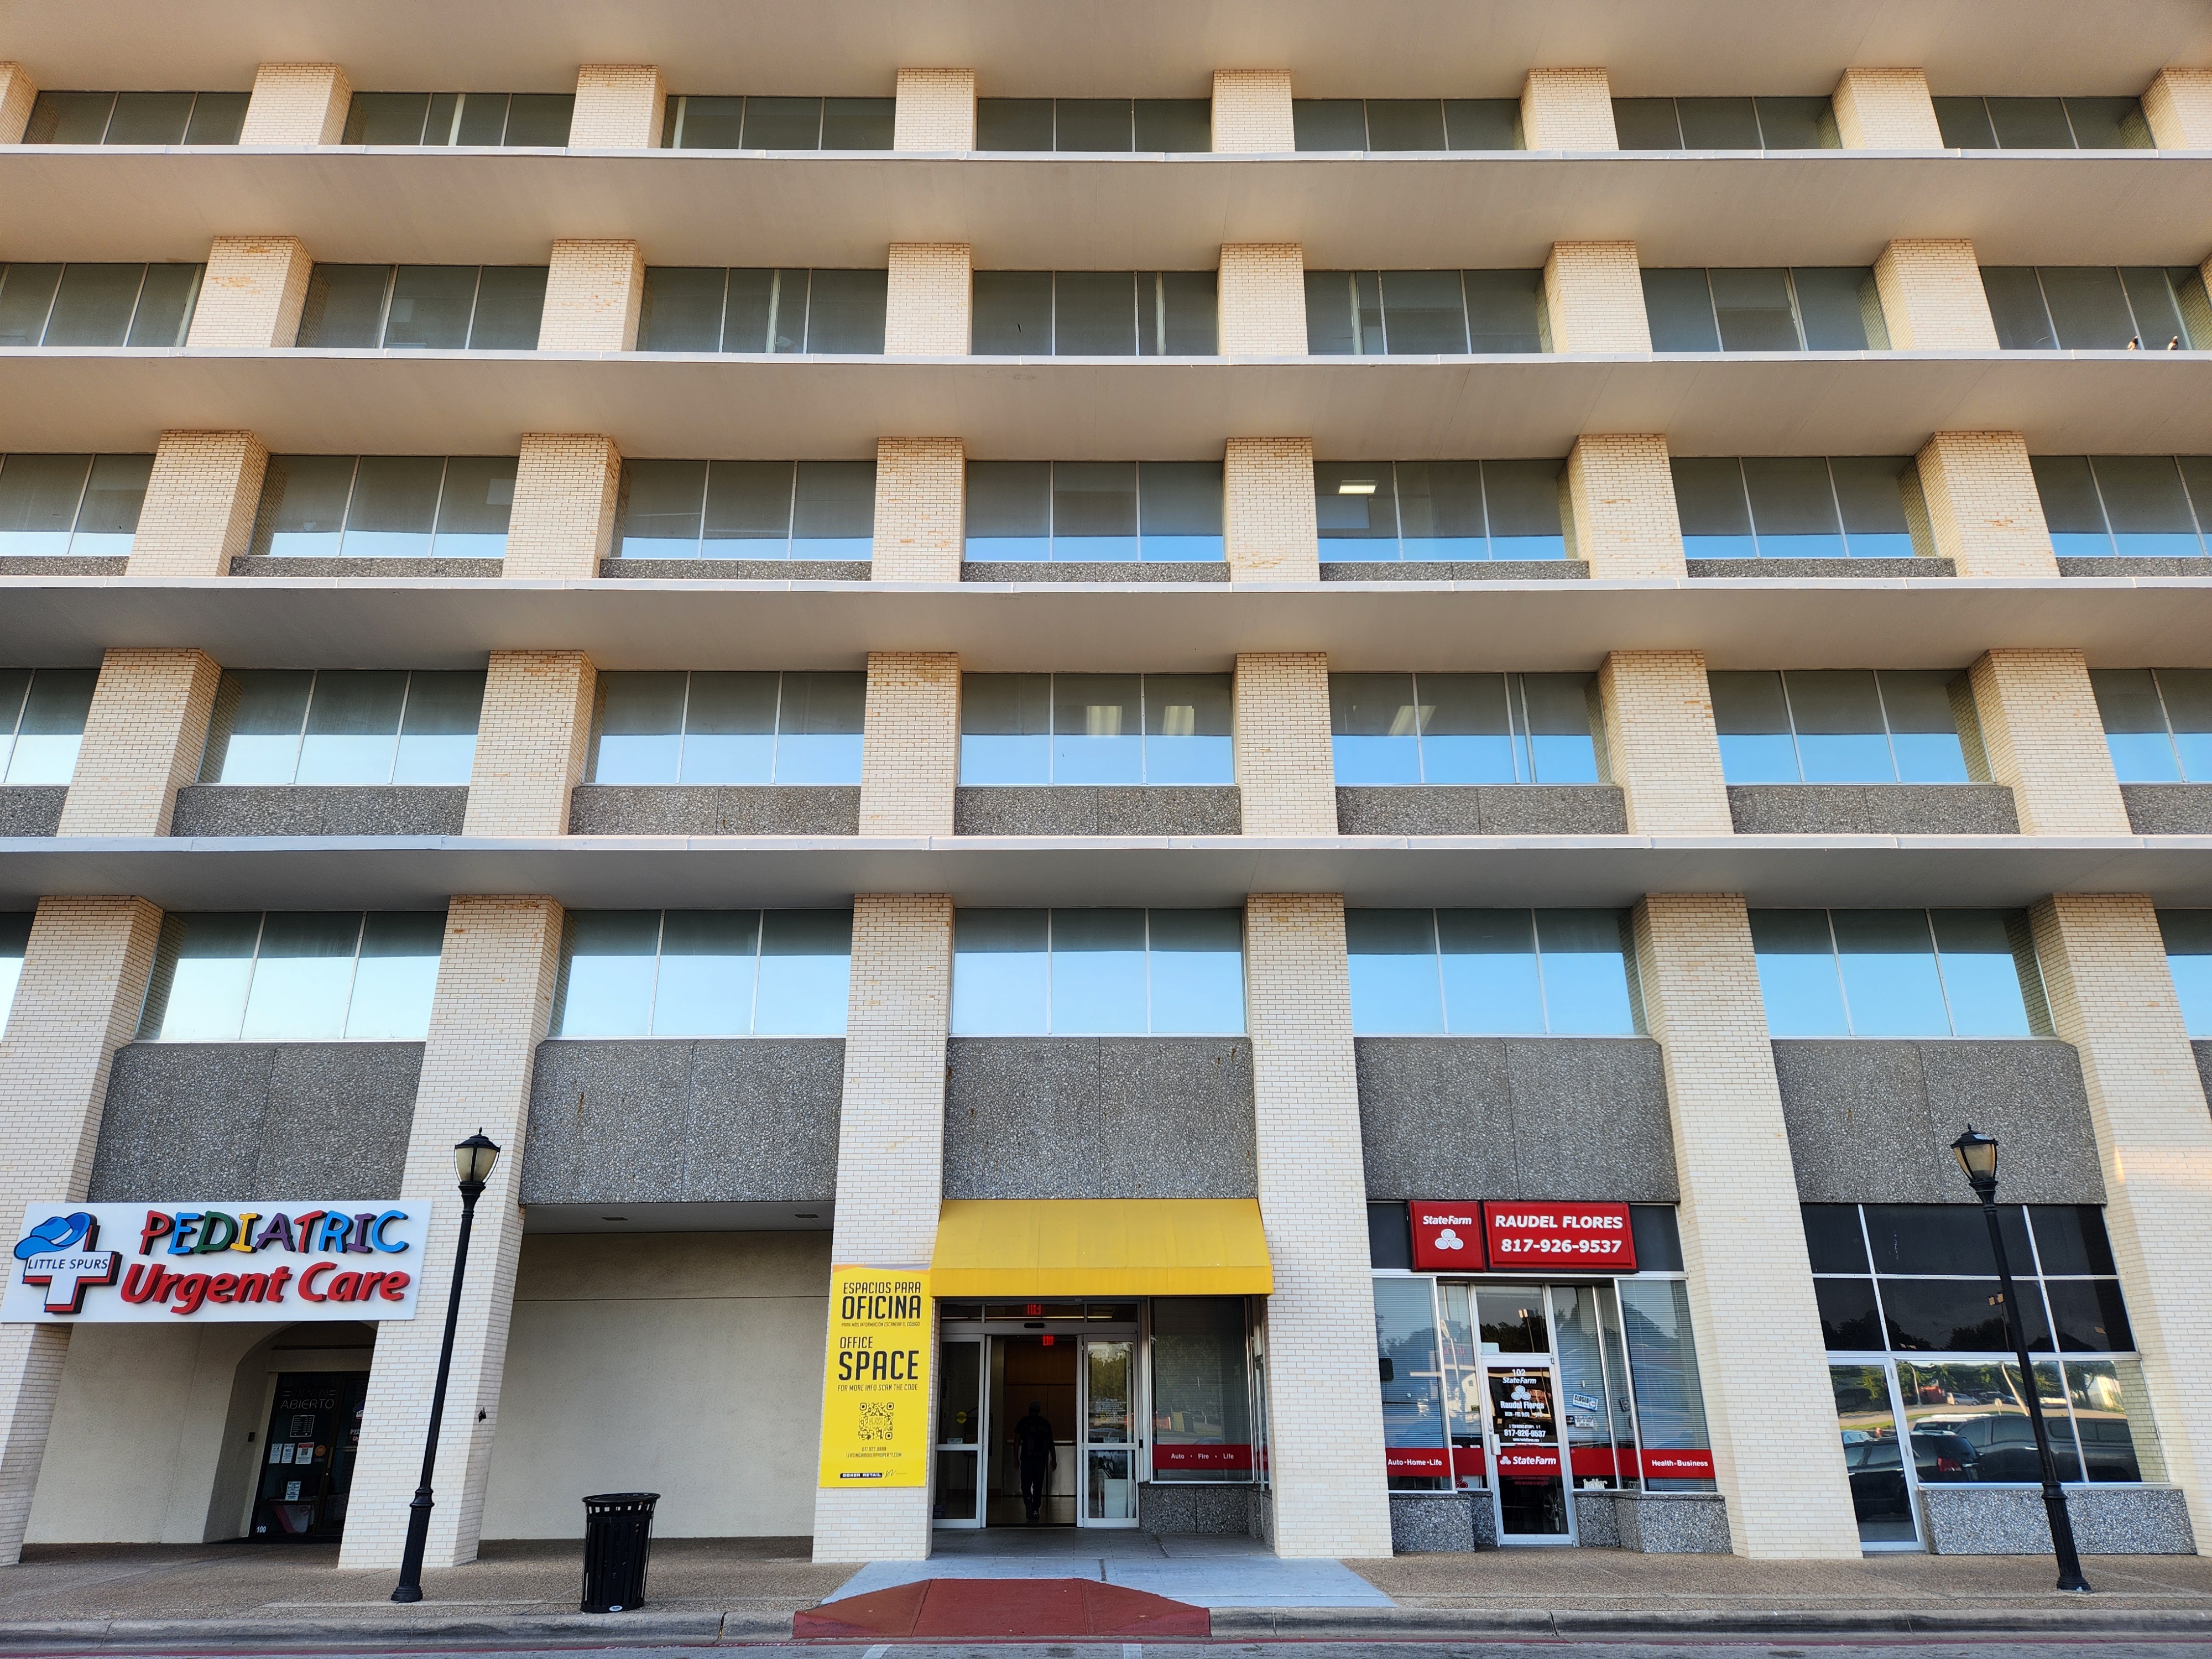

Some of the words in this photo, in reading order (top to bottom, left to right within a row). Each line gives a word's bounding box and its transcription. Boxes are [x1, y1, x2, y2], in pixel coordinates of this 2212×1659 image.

[1495, 1215, 1558, 1228] RAUDEL
[1562, 1215, 1623, 1229] FLORES
[138, 1209, 409, 1255] PEDIATRIC
[1501, 1238, 1622, 1254] 817-926-9537
[28, 1259, 66, 1269] LITTLE
[69, 1259, 108, 1269] SPURS
[121, 1263, 293, 1314] Urgent
[298, 1261, 411, 1302] Care
[843, 1282, 891, 1294] ESPACIOS
[895, 1281, 921, 1293] PARA
[842, 1295, 921, 1319] OFICINA
[840, 1337, 873, 1348] OFFICE
[838, 1350, 919, 1380] SPACE
[280, 1399, 335, 1410] ABIERTO
[1574, 1395, 1589, 1404] CLOSED
[1583, 1478, 1608, 1489] hello
